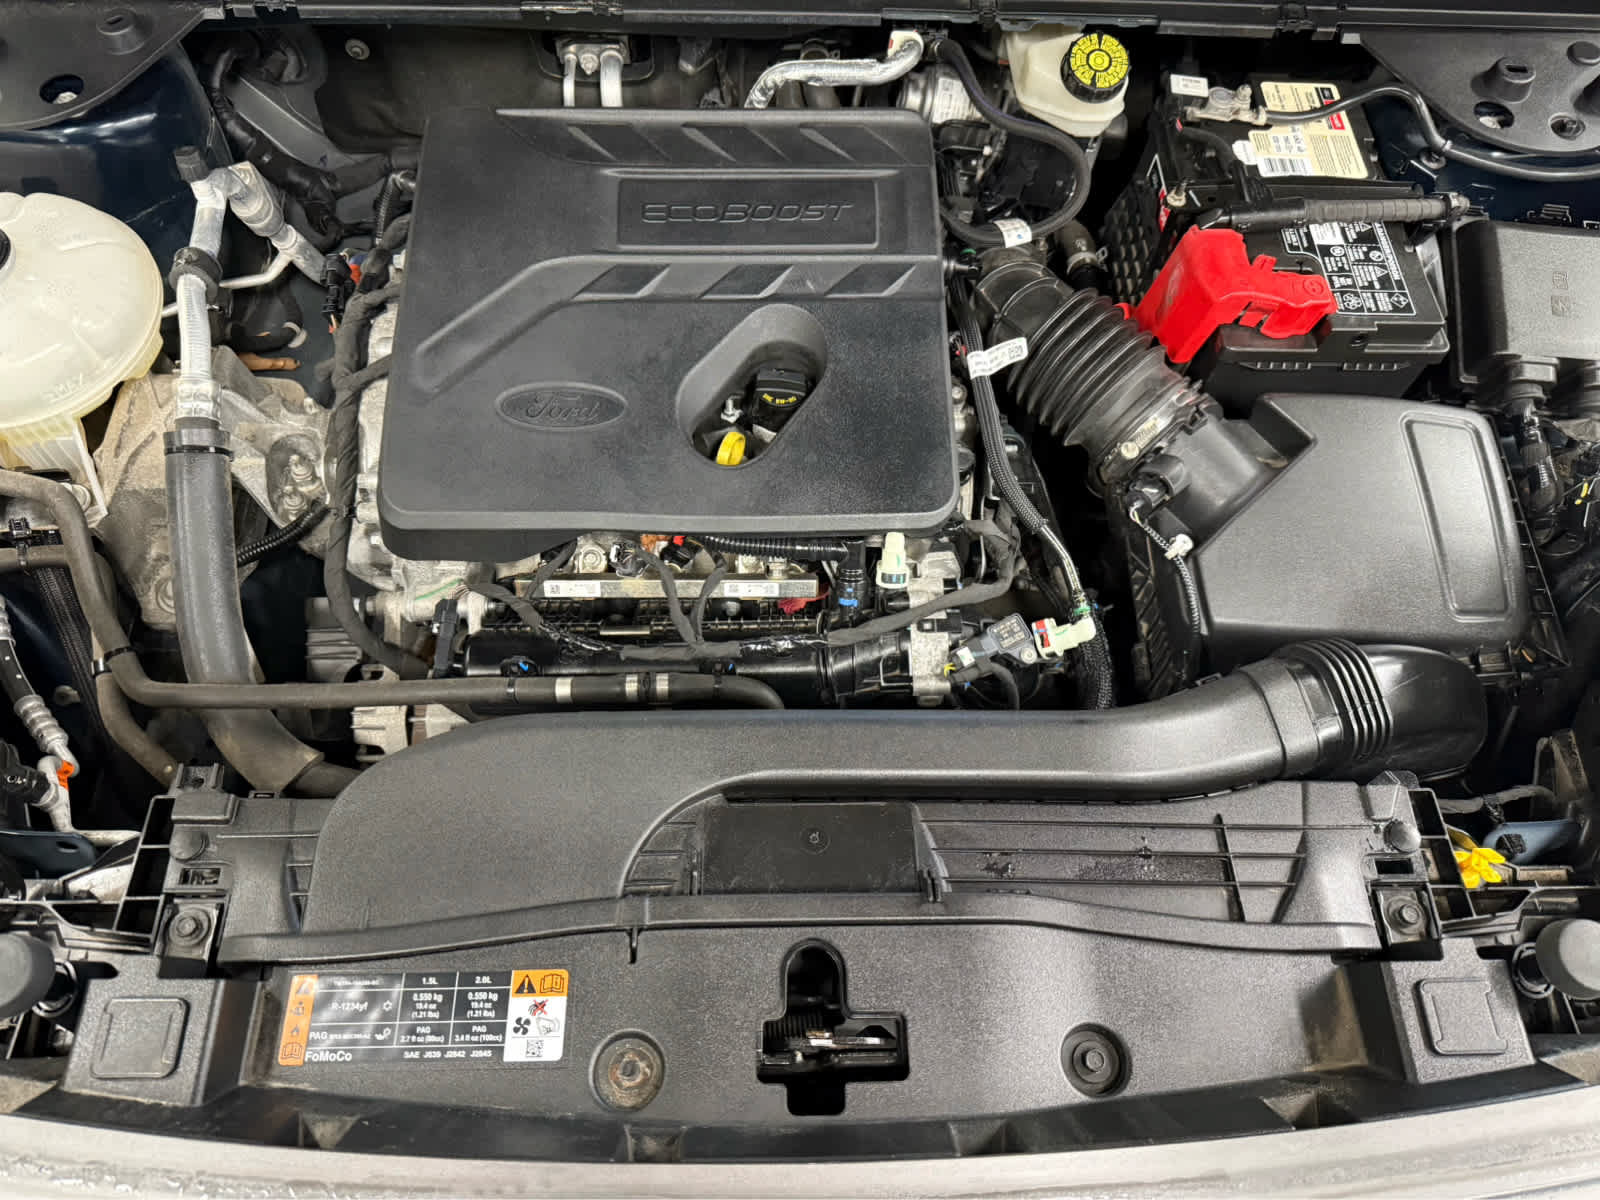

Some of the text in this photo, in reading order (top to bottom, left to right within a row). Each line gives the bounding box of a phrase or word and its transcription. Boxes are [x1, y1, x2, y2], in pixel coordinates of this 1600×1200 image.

[525, 391, 602, 423] Ford
[422, 977, 438, 985] 1.5L
[475, 976, 492, 984] 2.0L
[413, 993, 443, 1003] 0.550 kg
[468, 992, 498, 1001] 0.550 kg
[330, 1001, 368, 1012] R-1234yf
[416, 1026, 431, 1034] PAG
[472, 1025, 487, 1033] PAG
[309, 1031, 328, 1041] PAG
[304, 1050, 353, 1062] FoMoCo
[404, 1051, 420, 1059] SAE
